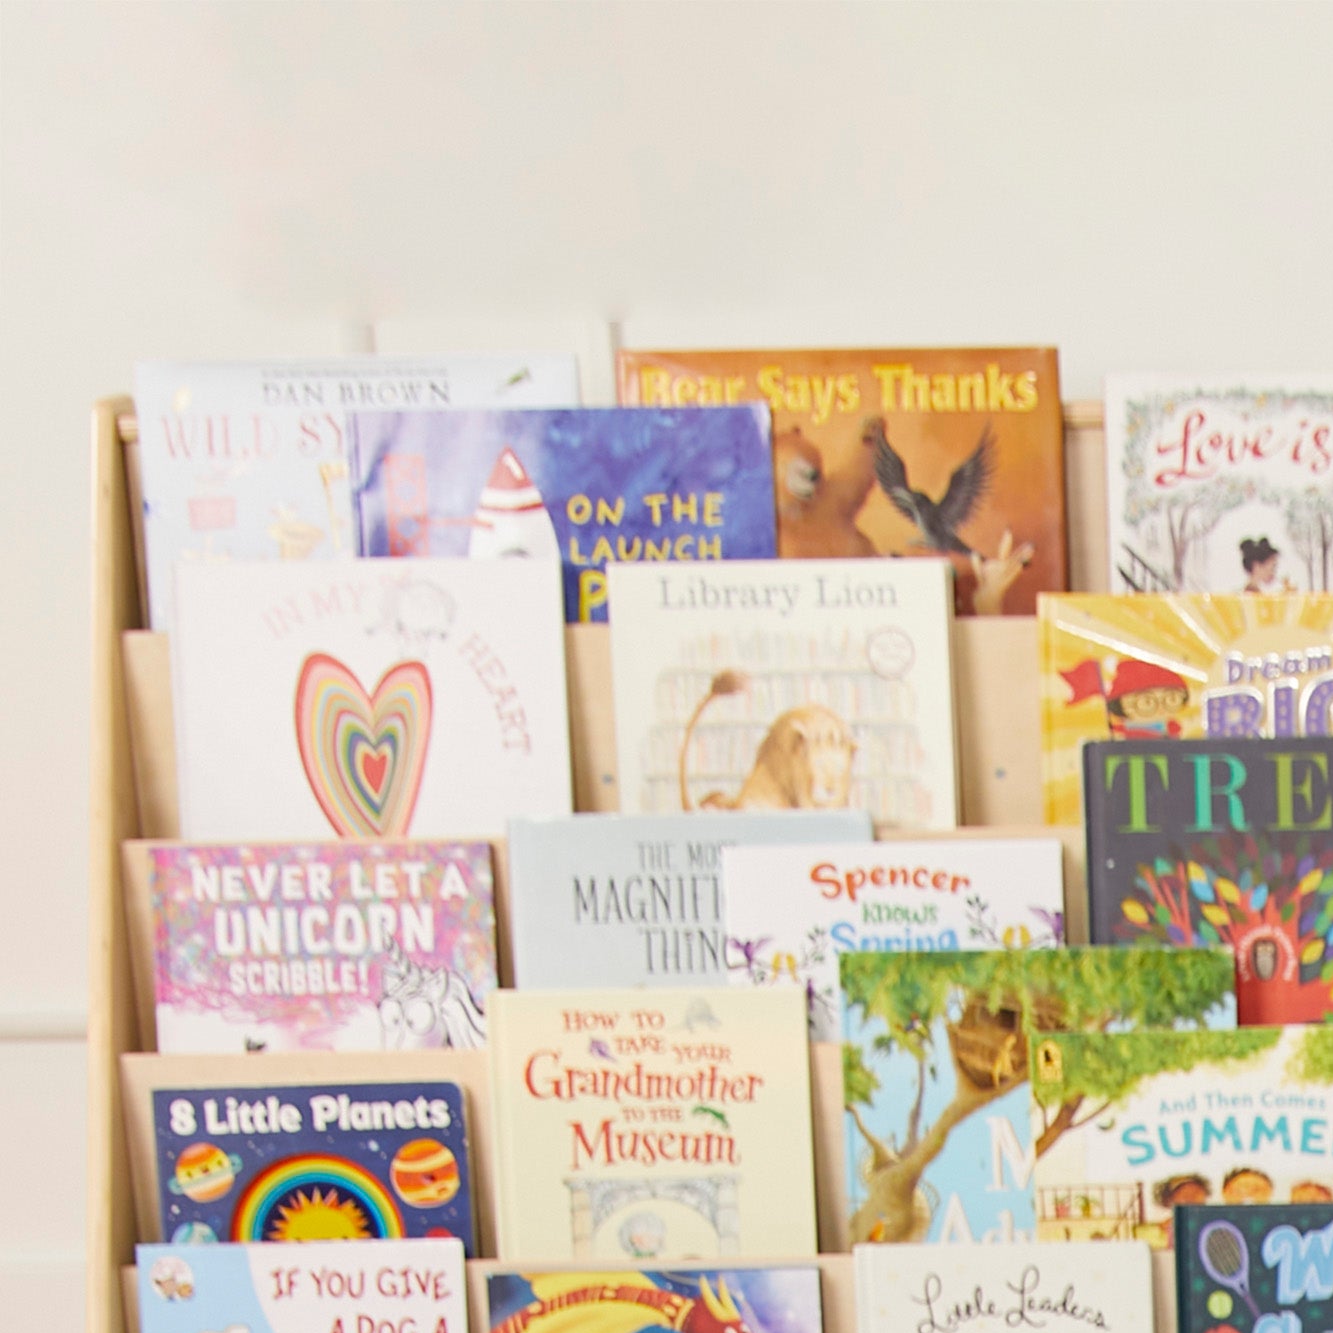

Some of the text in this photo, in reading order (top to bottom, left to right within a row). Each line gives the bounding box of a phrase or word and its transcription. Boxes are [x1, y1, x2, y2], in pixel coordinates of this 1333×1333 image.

[262, 380, 451, 406] DAN BROWN
[641, 363, 1038, 425] Bear Says Thanks
[161, 413, 280, 458] WILD
[1155, 411, 1278, 486] Love
[566, 492, 725, 527] ON THE
[569, 534, 722, 566] LAUNCH
[657, 576, 898, 618] Library Lion
[1225, 645, 1333, 684] Dream
[191, 862, 469, 902] NEVER LET A
[810, 862, 971, 902] Spencer
[214, 904, 436, 956] UNICORN
[638, 927, 726, 975] THIN
[229, 960, 370, 996] SCRIBBLE!
[631, 1010, 665, 1030] TO
[614, 1034, 733, 1064] TAKE YOUR
[525, 1048, 764, 1104] Grandmother
[169, 1093, 451, 1136] 8 Little Planets
[1158, 1090, 1327, 1115] And Then Comes
[569, 1117, 741, 1171] Museum
[271, 1268, 452, 1301] IF YOU GIVE
